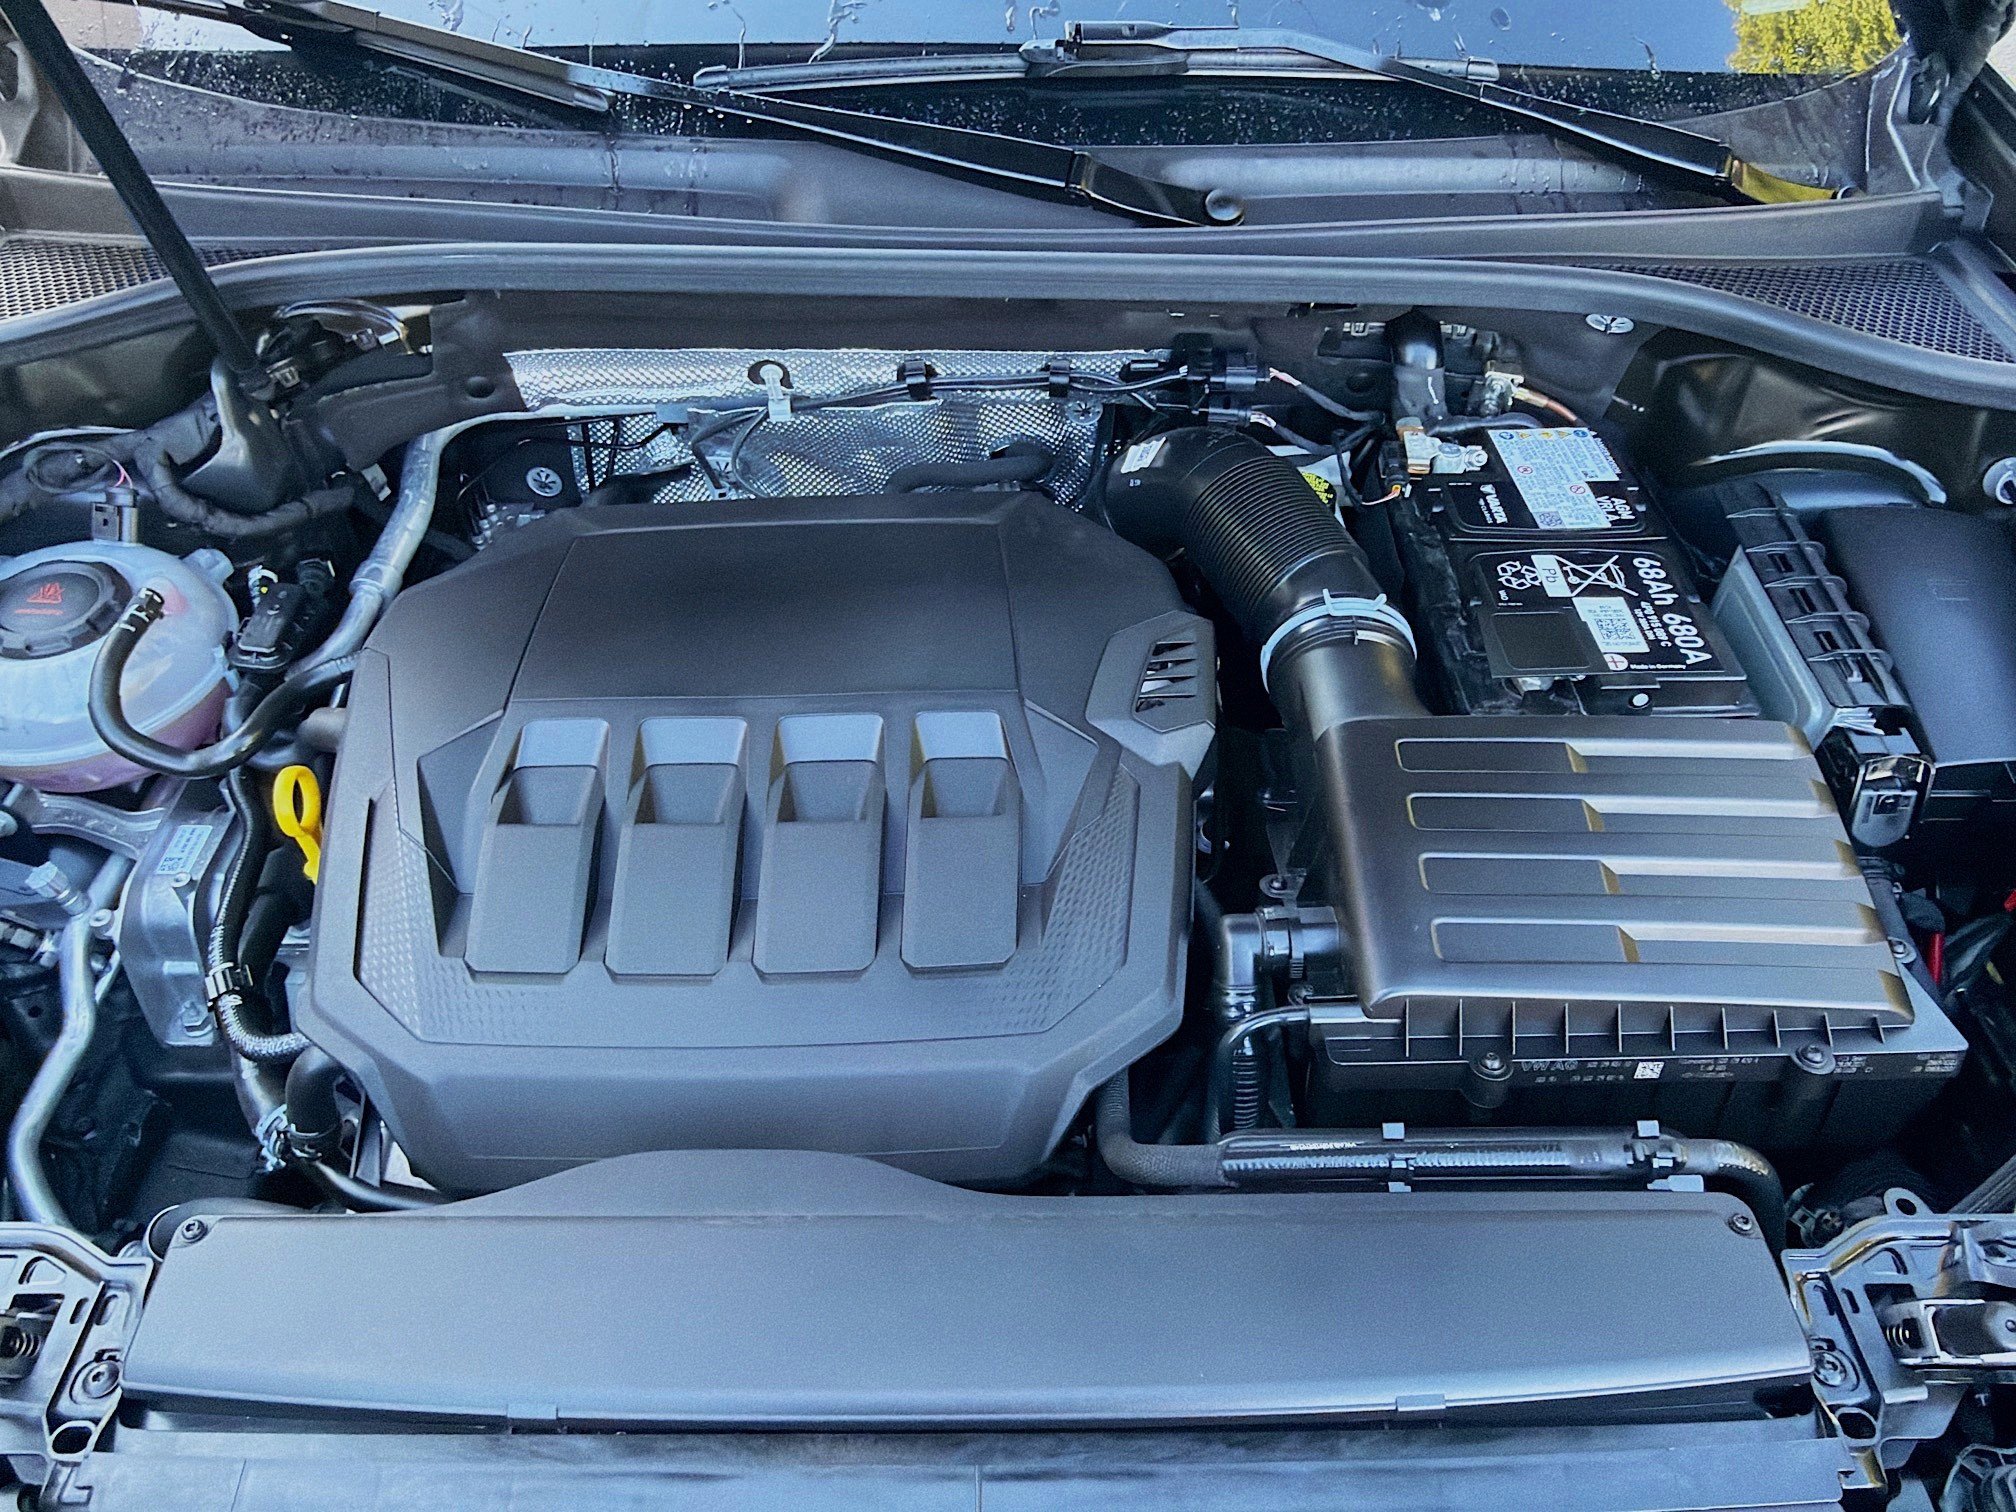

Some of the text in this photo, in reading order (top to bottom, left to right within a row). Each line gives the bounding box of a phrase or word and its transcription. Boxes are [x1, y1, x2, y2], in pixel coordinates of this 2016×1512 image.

[1486, 494, 1508, 524] VARTA
[1596, 495, 1620, 522] VRLA
[1610, 497, 1636, 520] AGM
[1542, 568, 1556, 583] Pb
[1632, 557, 1713, 665] 68Ah 680A
